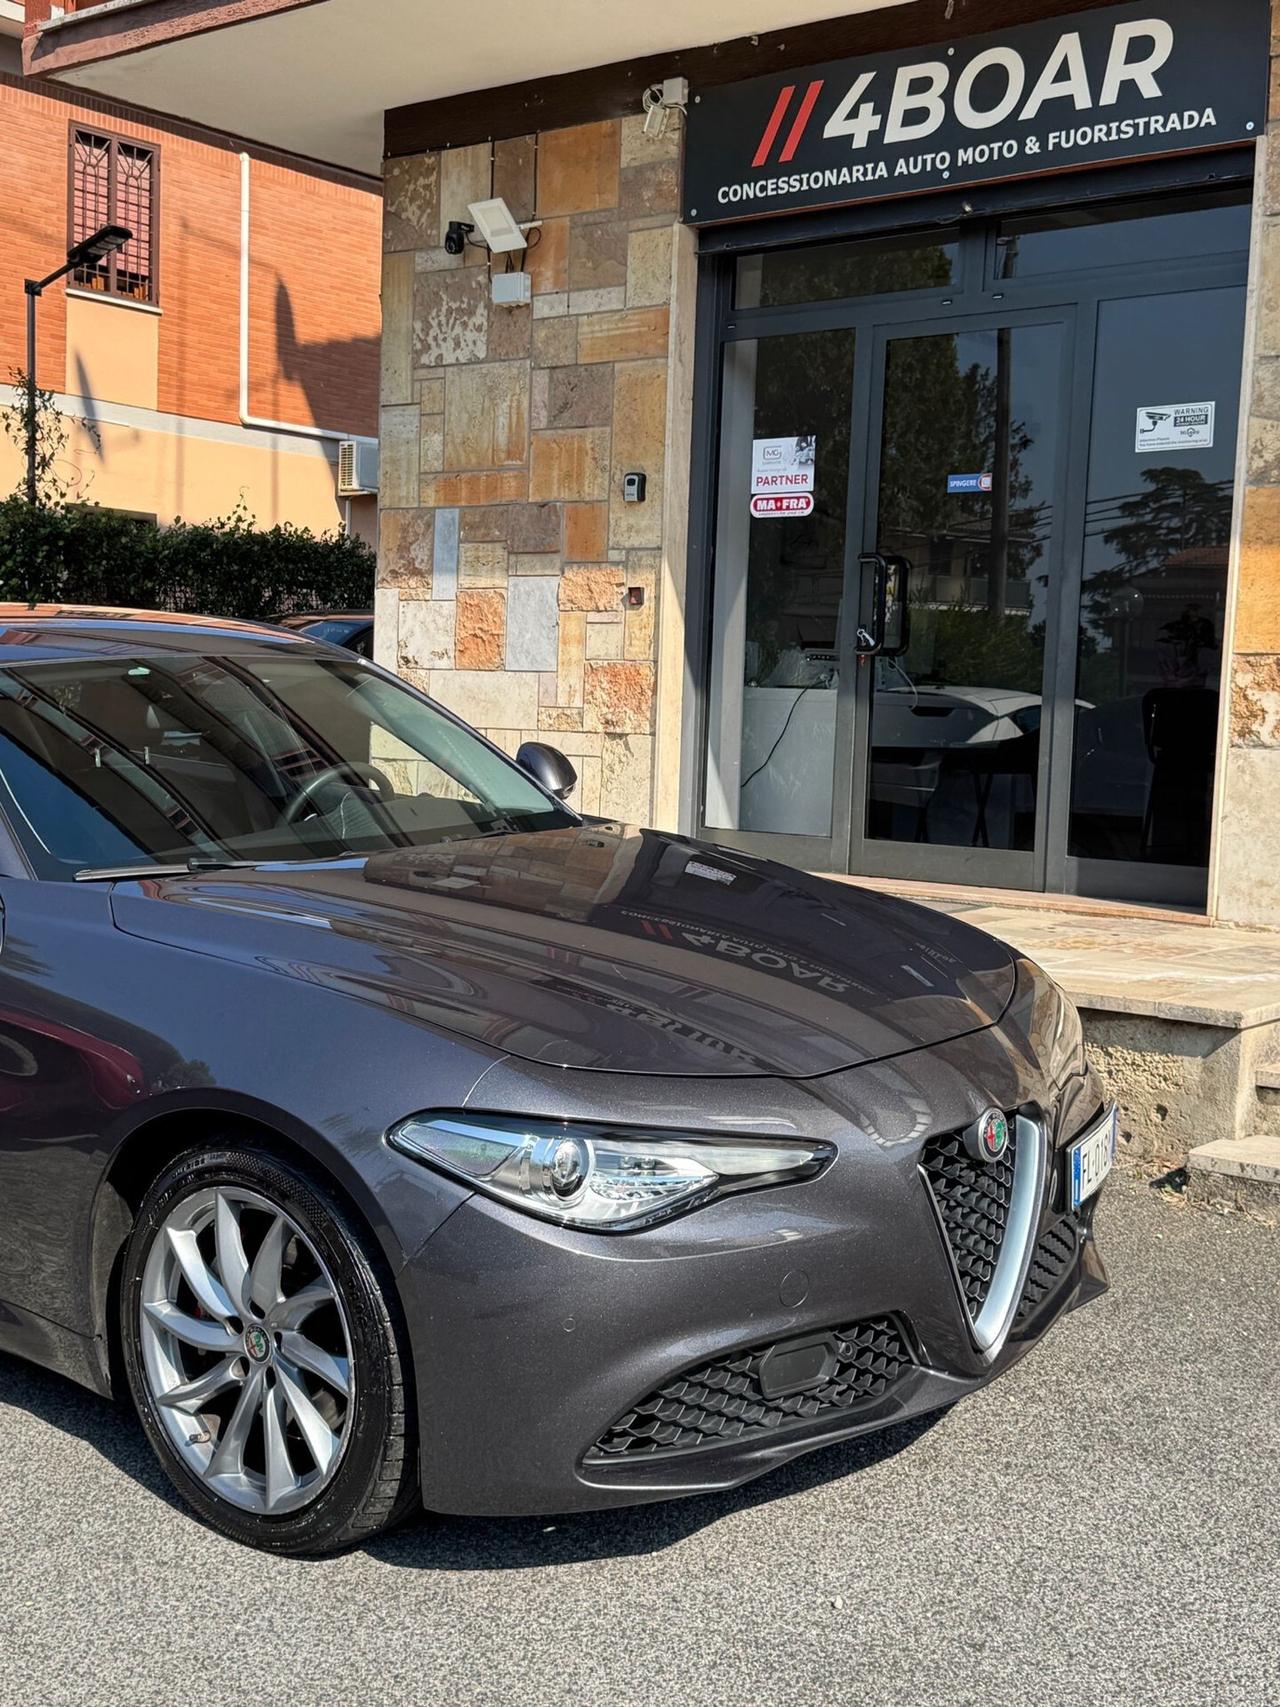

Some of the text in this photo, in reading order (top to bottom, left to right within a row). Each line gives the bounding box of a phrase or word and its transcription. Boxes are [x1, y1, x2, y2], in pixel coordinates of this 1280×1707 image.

[822, 18, 1174, 149] 4BOAR
[717, 107, 1217, 204] CONCESSIONARIA AUTO MOTO & FUORISTRADA
[1174, 406, 1209, 416] WARNING
[1185, 415, 1206, 423] HOUR
[756, 474, 809, 487] PARTNER
